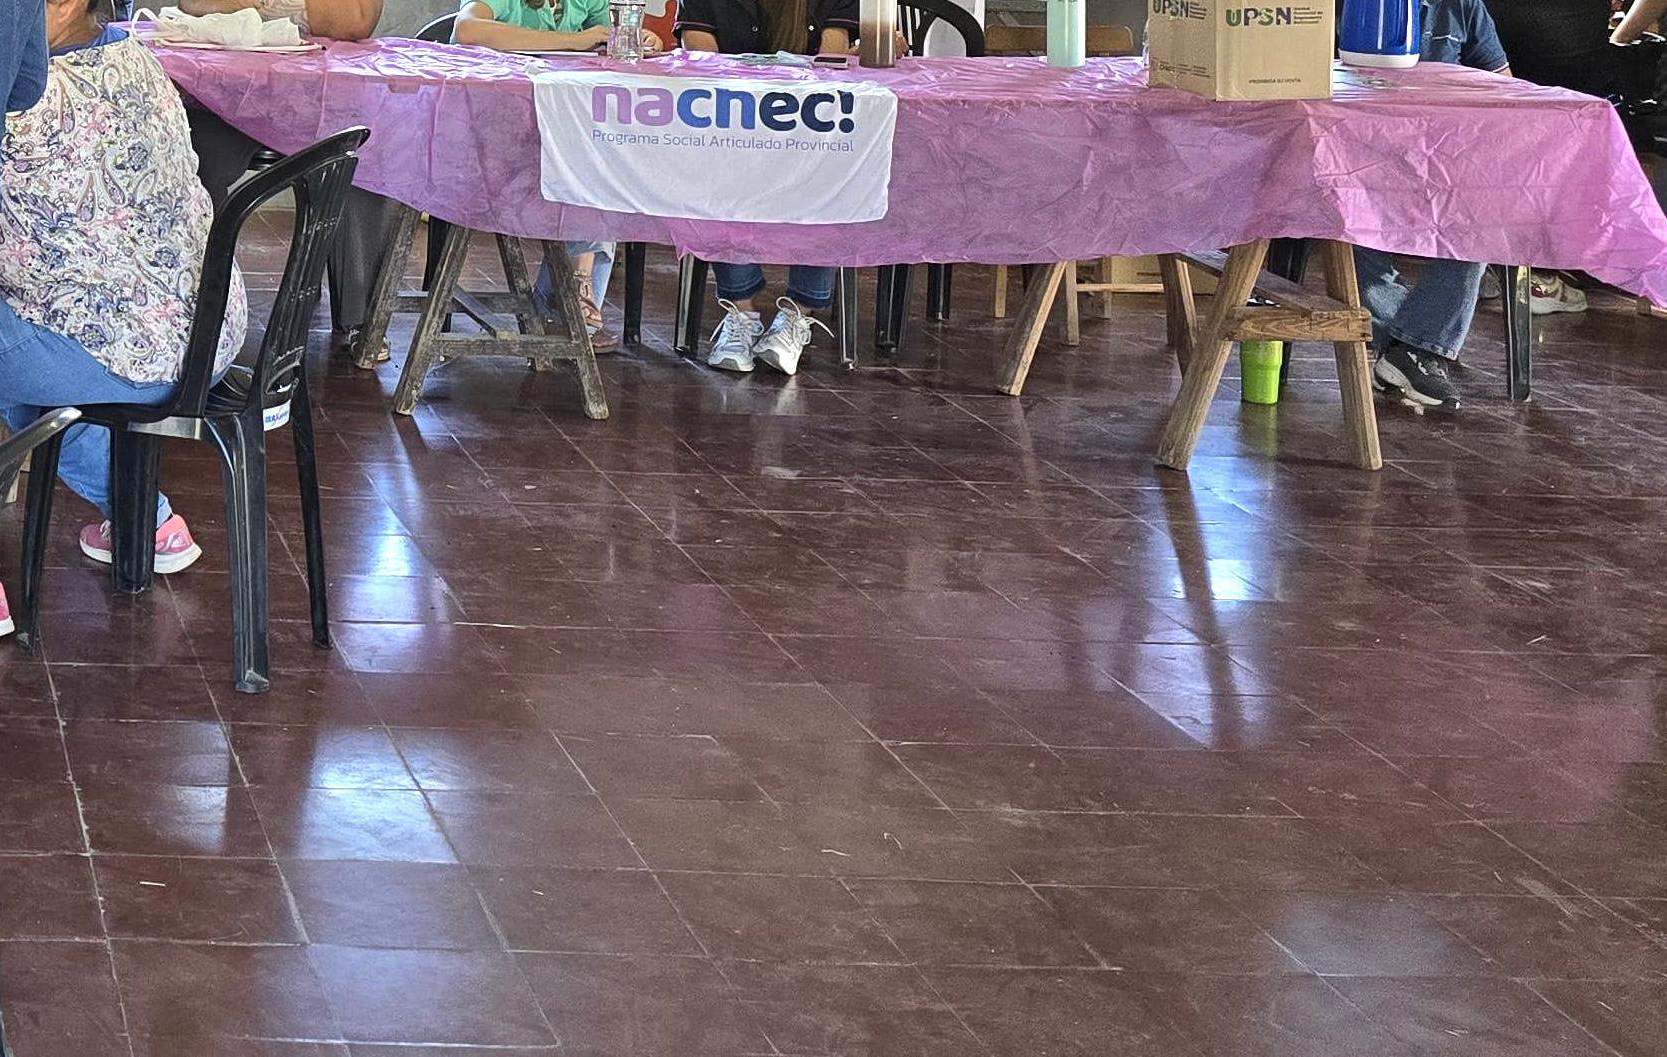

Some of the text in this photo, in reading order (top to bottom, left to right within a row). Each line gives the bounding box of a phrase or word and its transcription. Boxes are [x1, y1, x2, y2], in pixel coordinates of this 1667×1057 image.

[1225, 7, 1292, 27] UPSN
[592, 129, 854, 152] Programa Social Articulado Provincial
